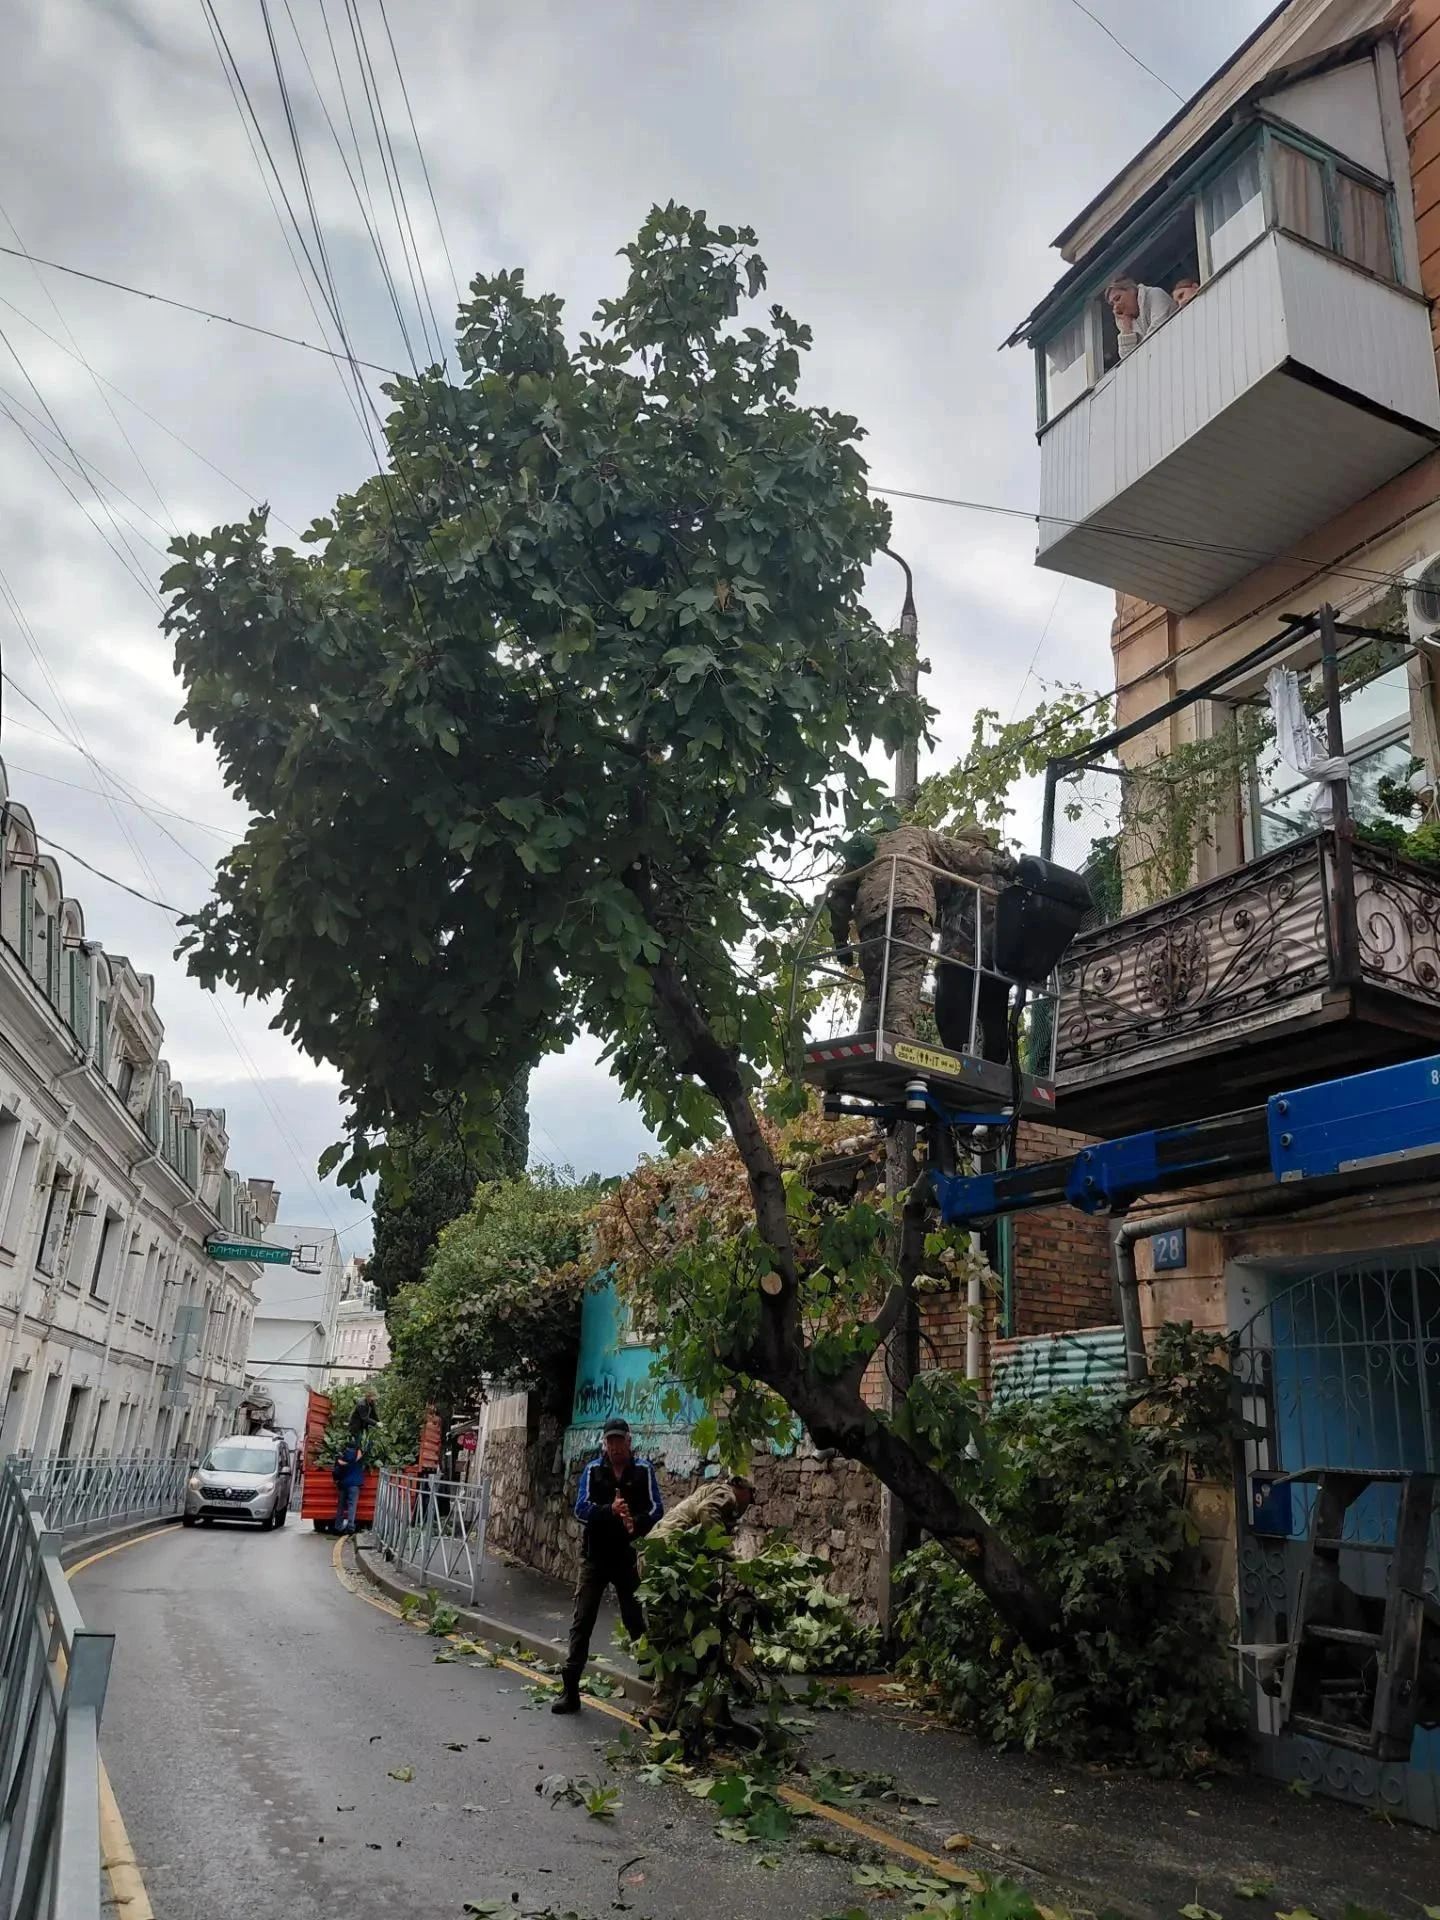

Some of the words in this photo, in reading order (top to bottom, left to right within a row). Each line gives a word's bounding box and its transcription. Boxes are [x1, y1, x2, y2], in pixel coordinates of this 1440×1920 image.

[208, 1246, 248, 1256] ОЛИМП
[250, 1250, 290, 1260] ЦЕНТР
[1157, 1235, 1180, 1263] 28
[1255, 1492, 1263, 1508] 9
